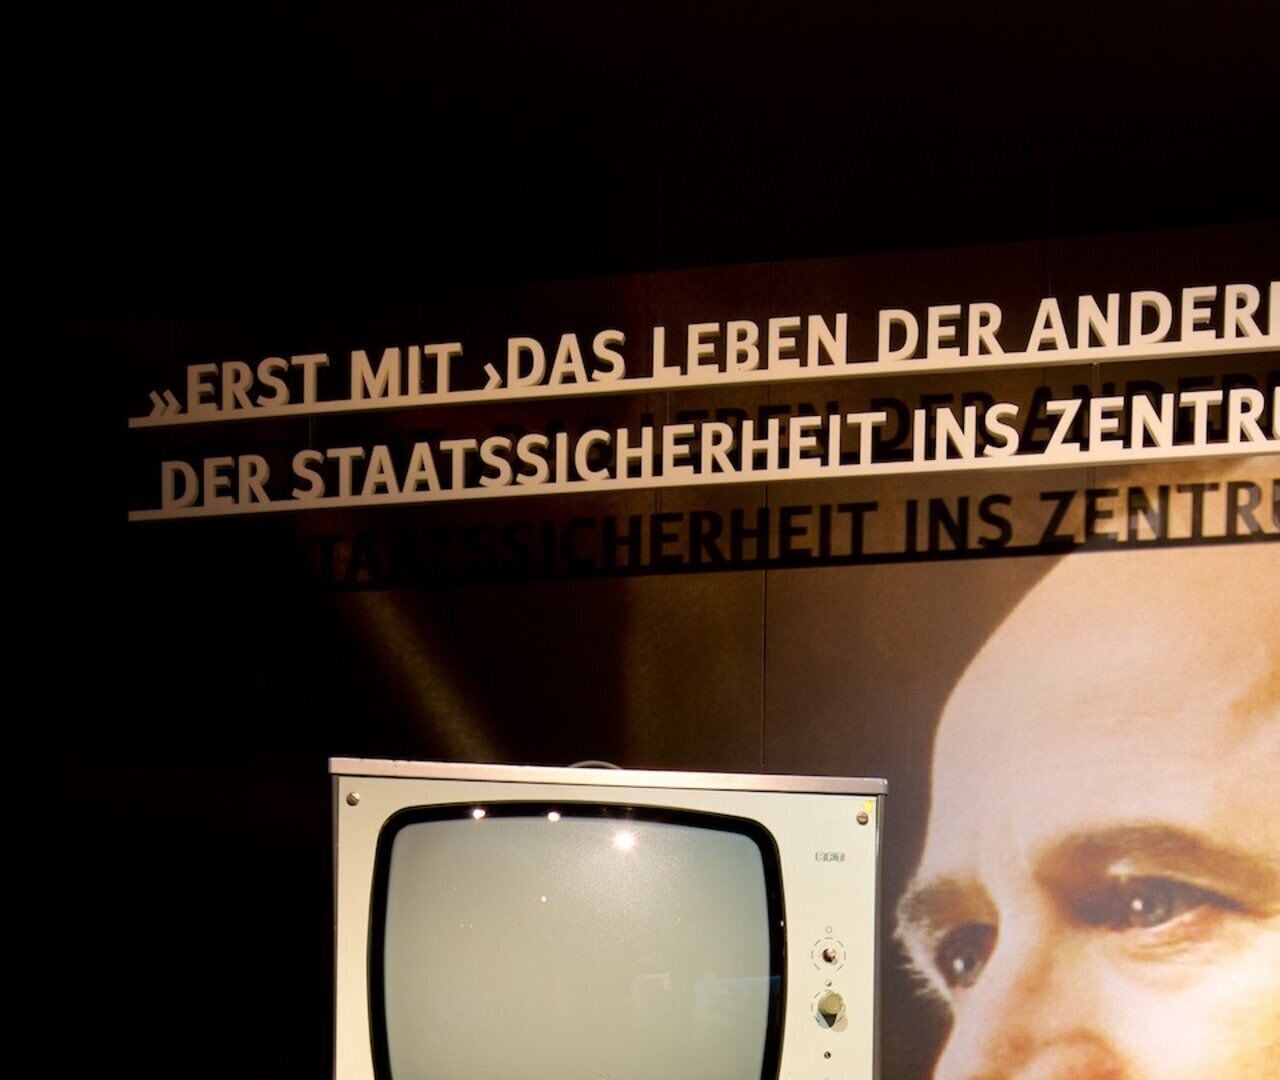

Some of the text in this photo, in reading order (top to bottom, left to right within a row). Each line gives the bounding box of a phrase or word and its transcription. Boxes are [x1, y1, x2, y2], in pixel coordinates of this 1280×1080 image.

[350, 342, 463, 398] MIT
[651, 313, 849, 380] LEBEN
[877, 303, 1002, 364] DER
[161, 454, 270, 508] DER
[293, 412, 886, 501] STAATSSICHERHEIT
[913, 403, 1020, 461] INS
